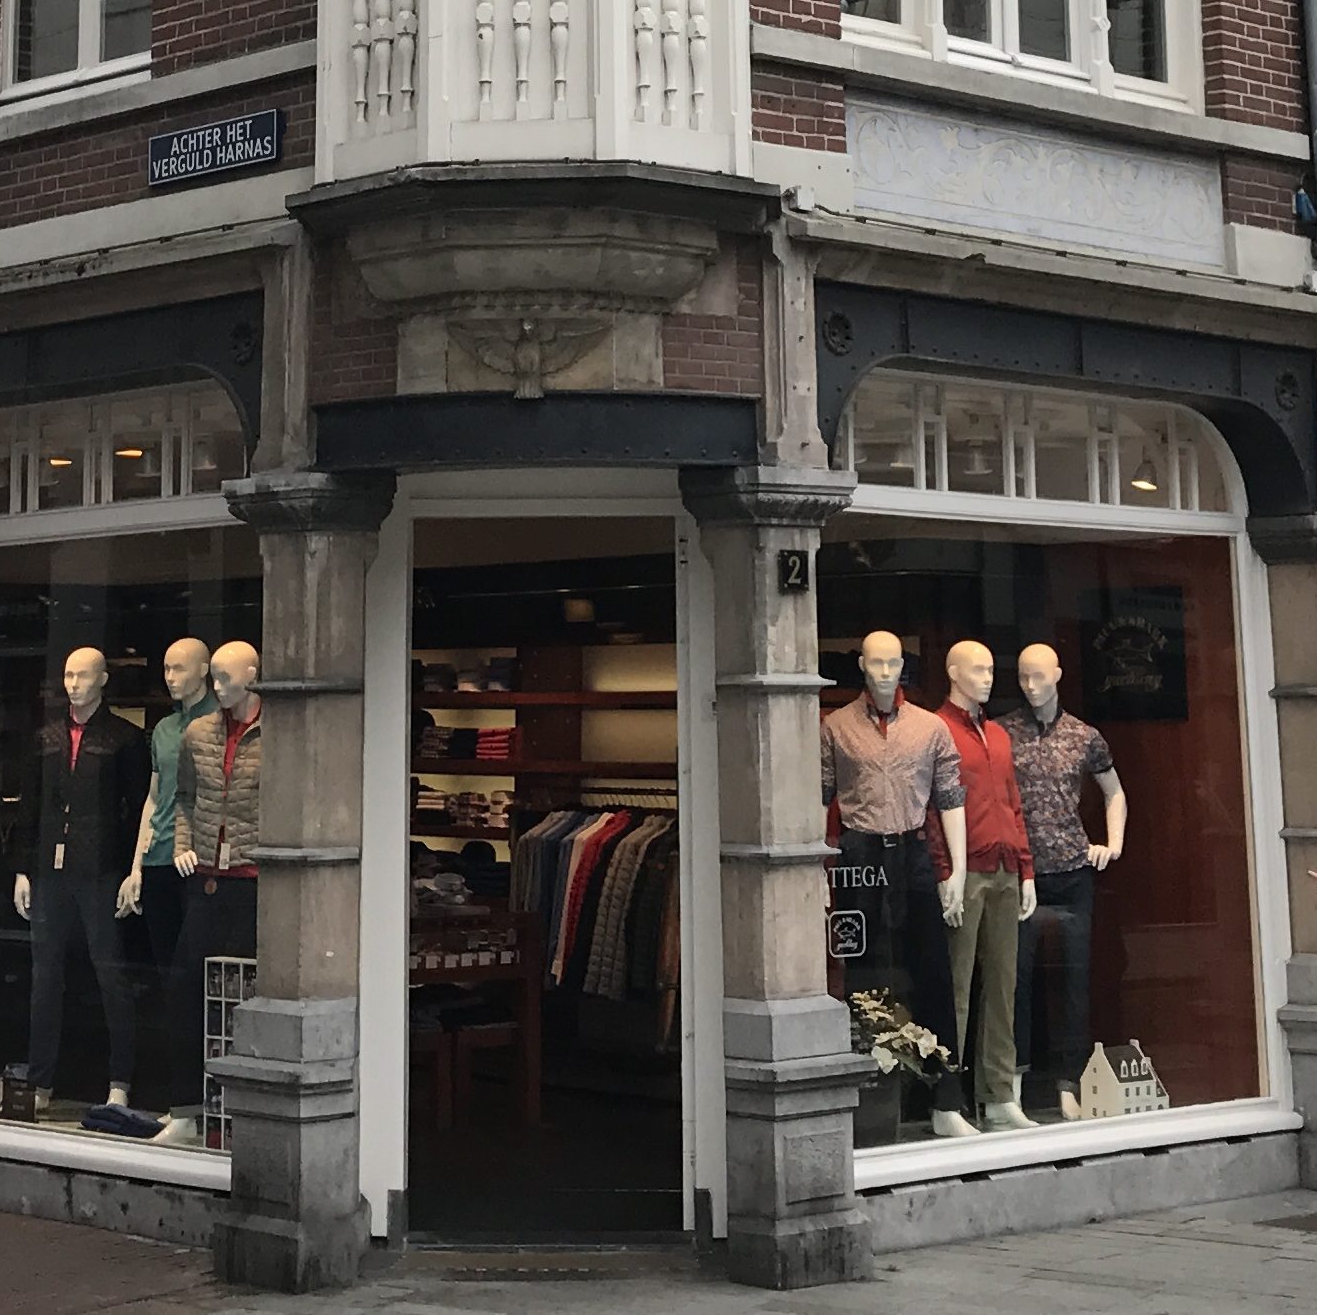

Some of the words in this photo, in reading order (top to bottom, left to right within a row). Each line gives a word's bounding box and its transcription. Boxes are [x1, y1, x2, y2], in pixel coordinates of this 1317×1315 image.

[170, 127, 221, 156] ACHTER
[226, 120, 252, 143] HET
[152, 149, 212, 178] VERGULD
[216, 136, 272, 165] HARNAS
[788, 556, 802, 584] 2
[824, 866, 889, 887] TTEGA
